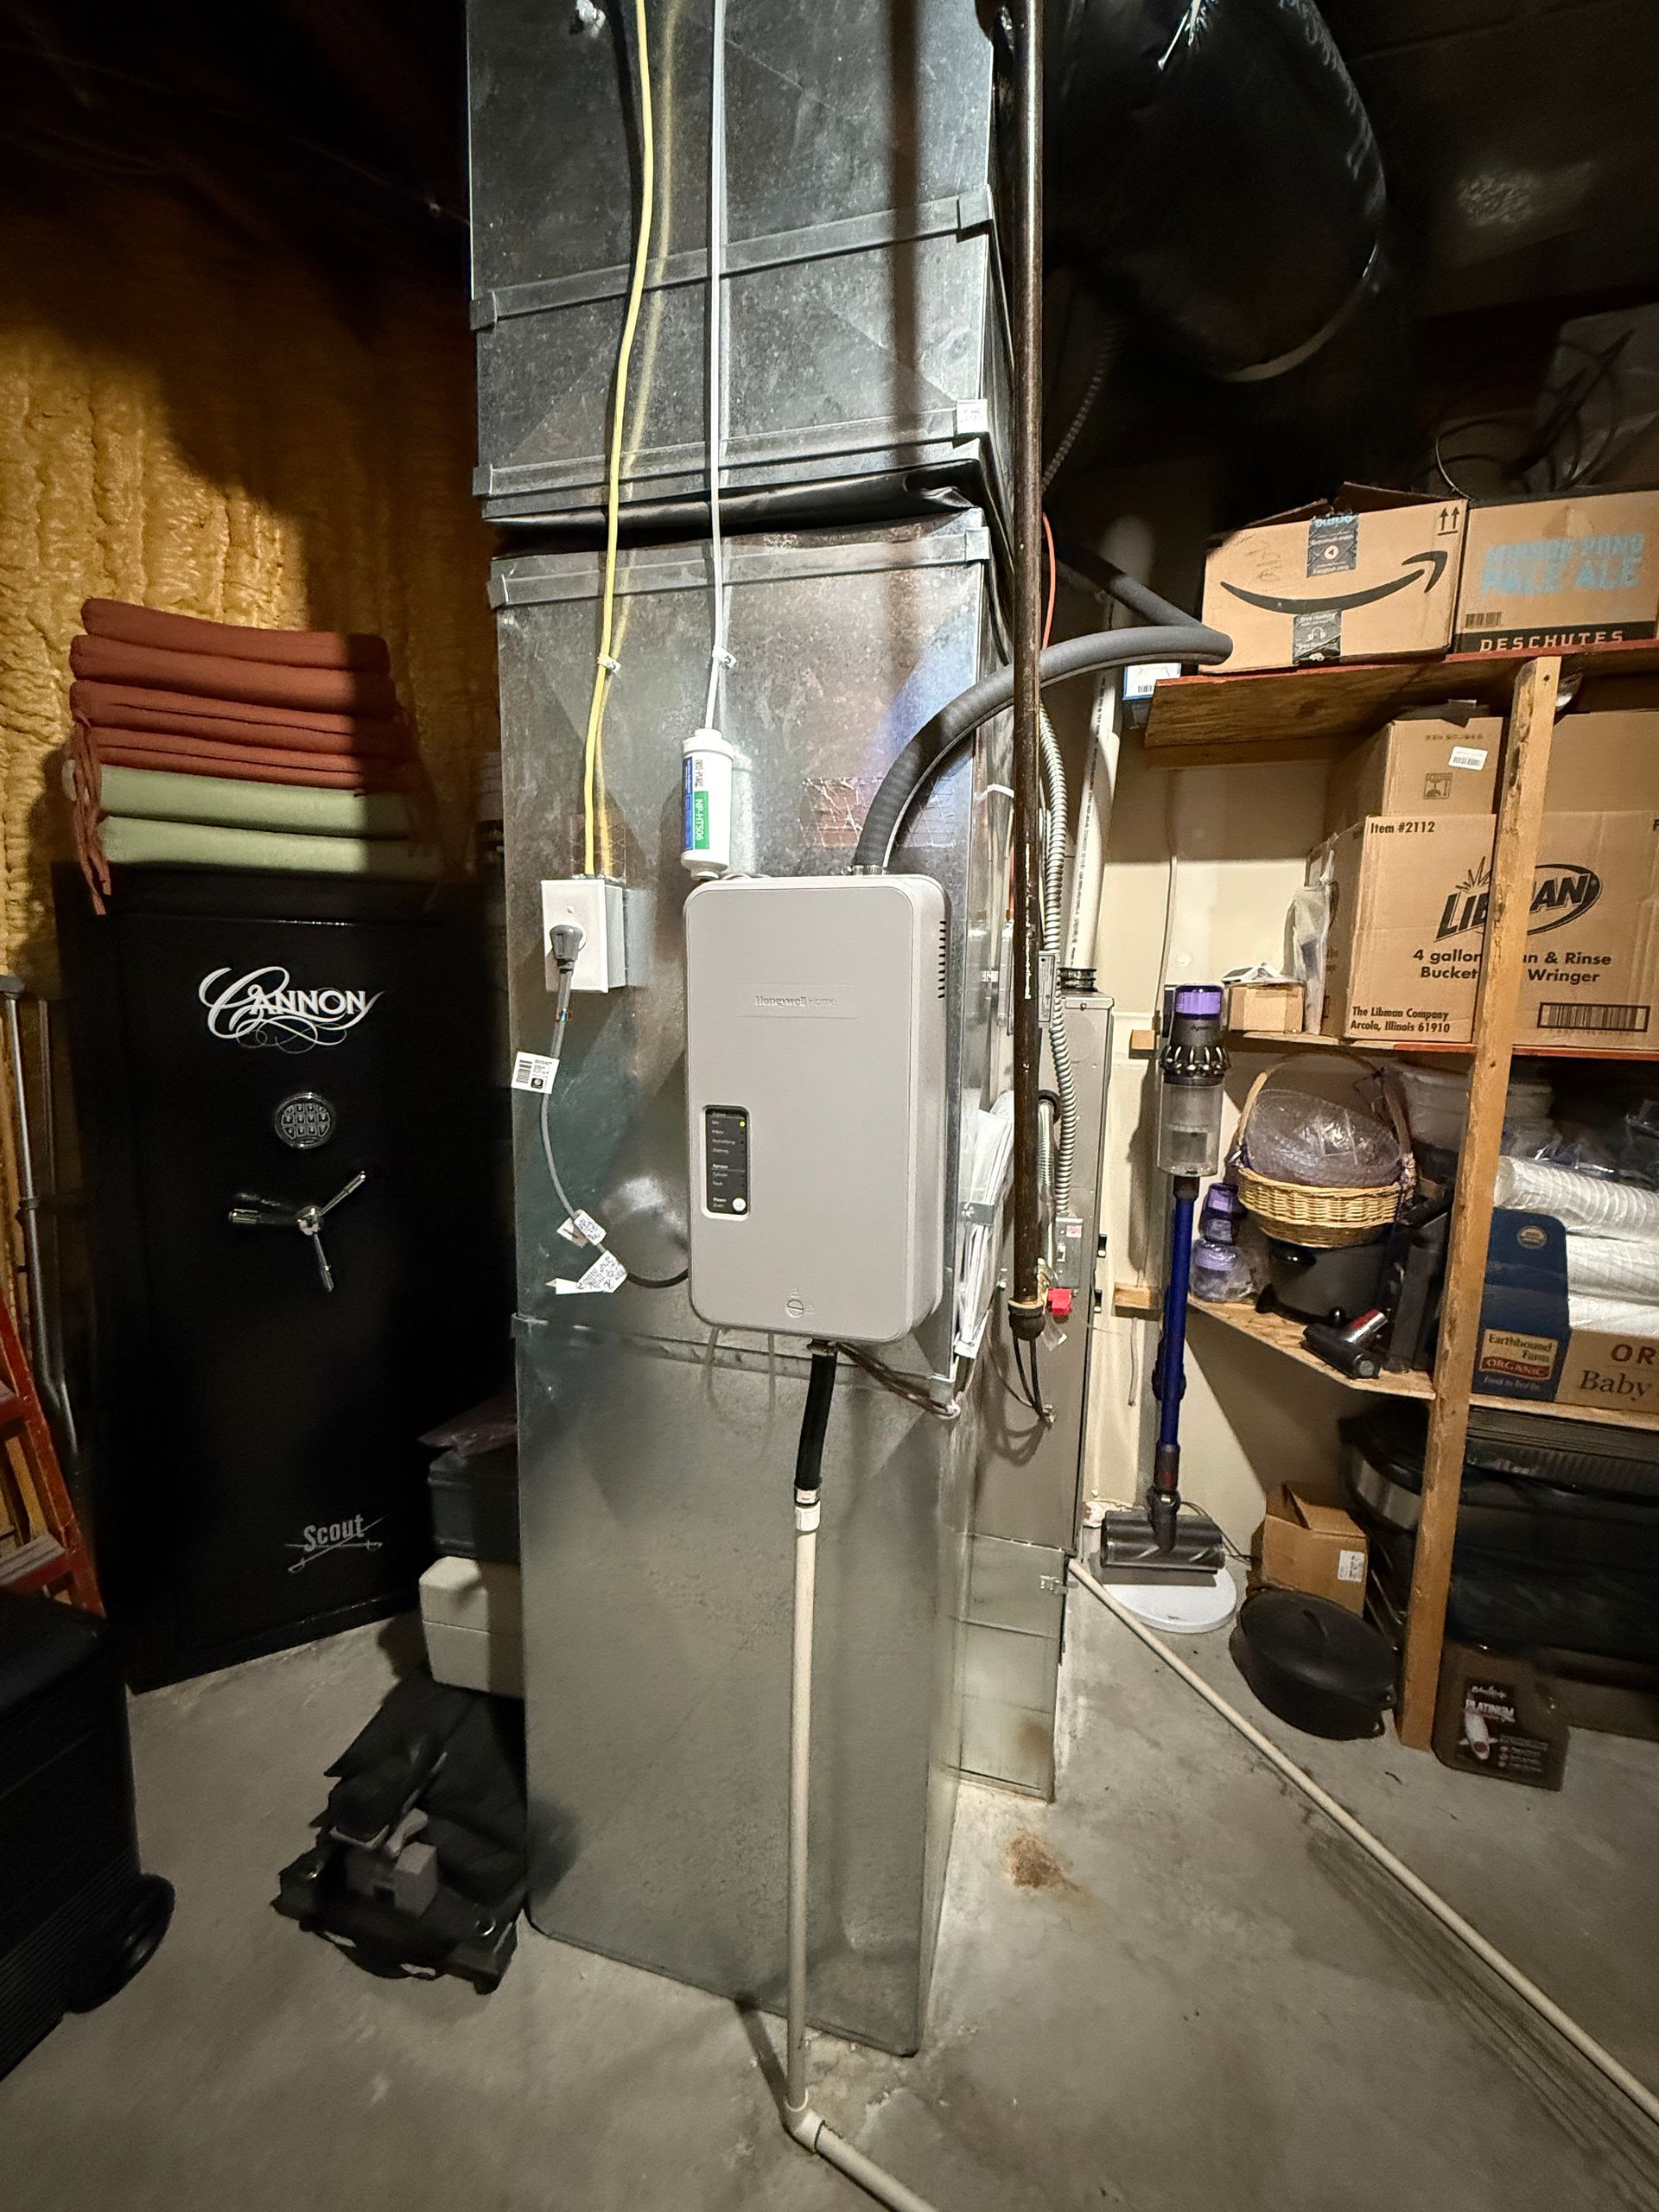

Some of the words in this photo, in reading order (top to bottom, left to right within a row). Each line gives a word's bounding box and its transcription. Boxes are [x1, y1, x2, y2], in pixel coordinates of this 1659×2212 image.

[1478, 630, 1624, 653] DESCHUTES
[1370, 823, 1395, 834] Item
[1398, 821, 1435, 834] #2112
[1435, 874, 1590, 941] LIBAN
[1413, 949, 1424, 960] 4
[1544, 952, 1558, 964] &
[1565, 951, 1612, 966] Rinse
[1421, 966, 1478, 980] Bucket
[1527, 969, 1600, 984] Wringer
[199, 965, 382, 1048] CANNON
[754, 995, 806, 1007] Honeywell
[1351, 1006, 1369, 1017] The
[1371, 1007, 1403, 1018] Libman
[1406, 1007, 1449, 1021] Company
[1350, 1020, 1382, 1032] Arcola,
[1385, 1020, 1415, 1033] Illinois
[1418, 1022, 1451, 1033] 61910
[1488, 1333, 1553, 1351] Earthbound
[1486, 1357, 1545, 1376] ORGANIC
[1579, 1370, 1651, 1402] Baby
[303, 1513, 365, 1553] Scout
